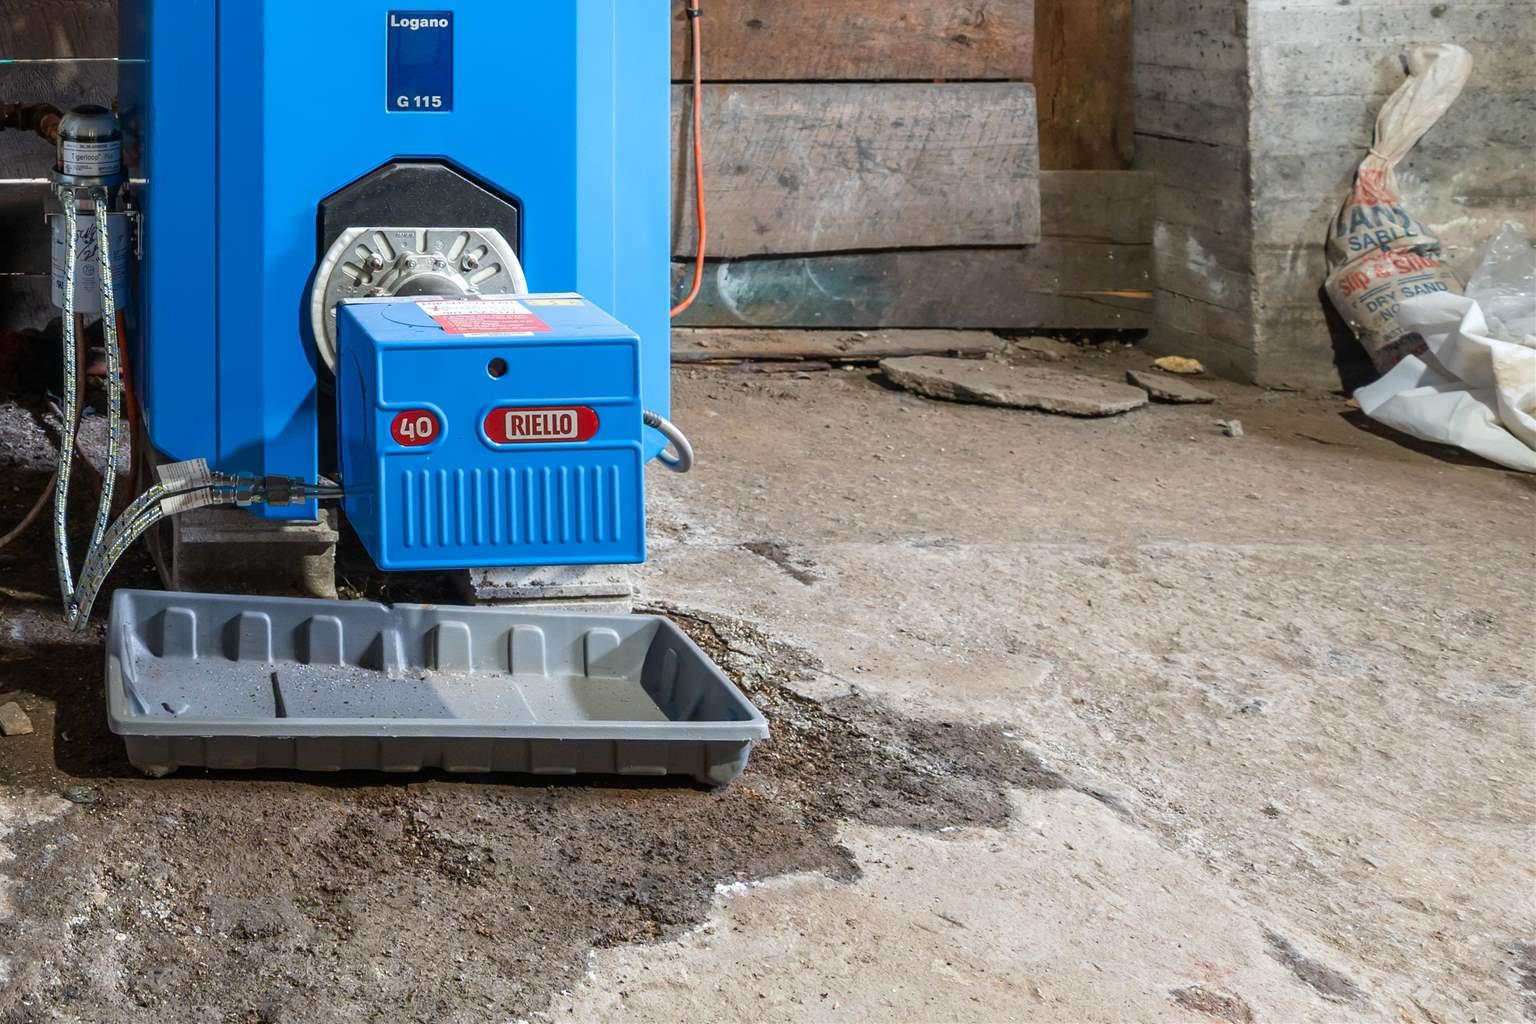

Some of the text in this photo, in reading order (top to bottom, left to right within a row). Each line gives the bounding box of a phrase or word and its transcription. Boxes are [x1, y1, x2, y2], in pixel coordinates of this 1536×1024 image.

[391, 15, 449, 30] Logano
[397, 95, 442, 108] G 115
[1366, 280, 1448, 312] DRY SAND
[400, 414, 572, 439] 40 RIELLO
